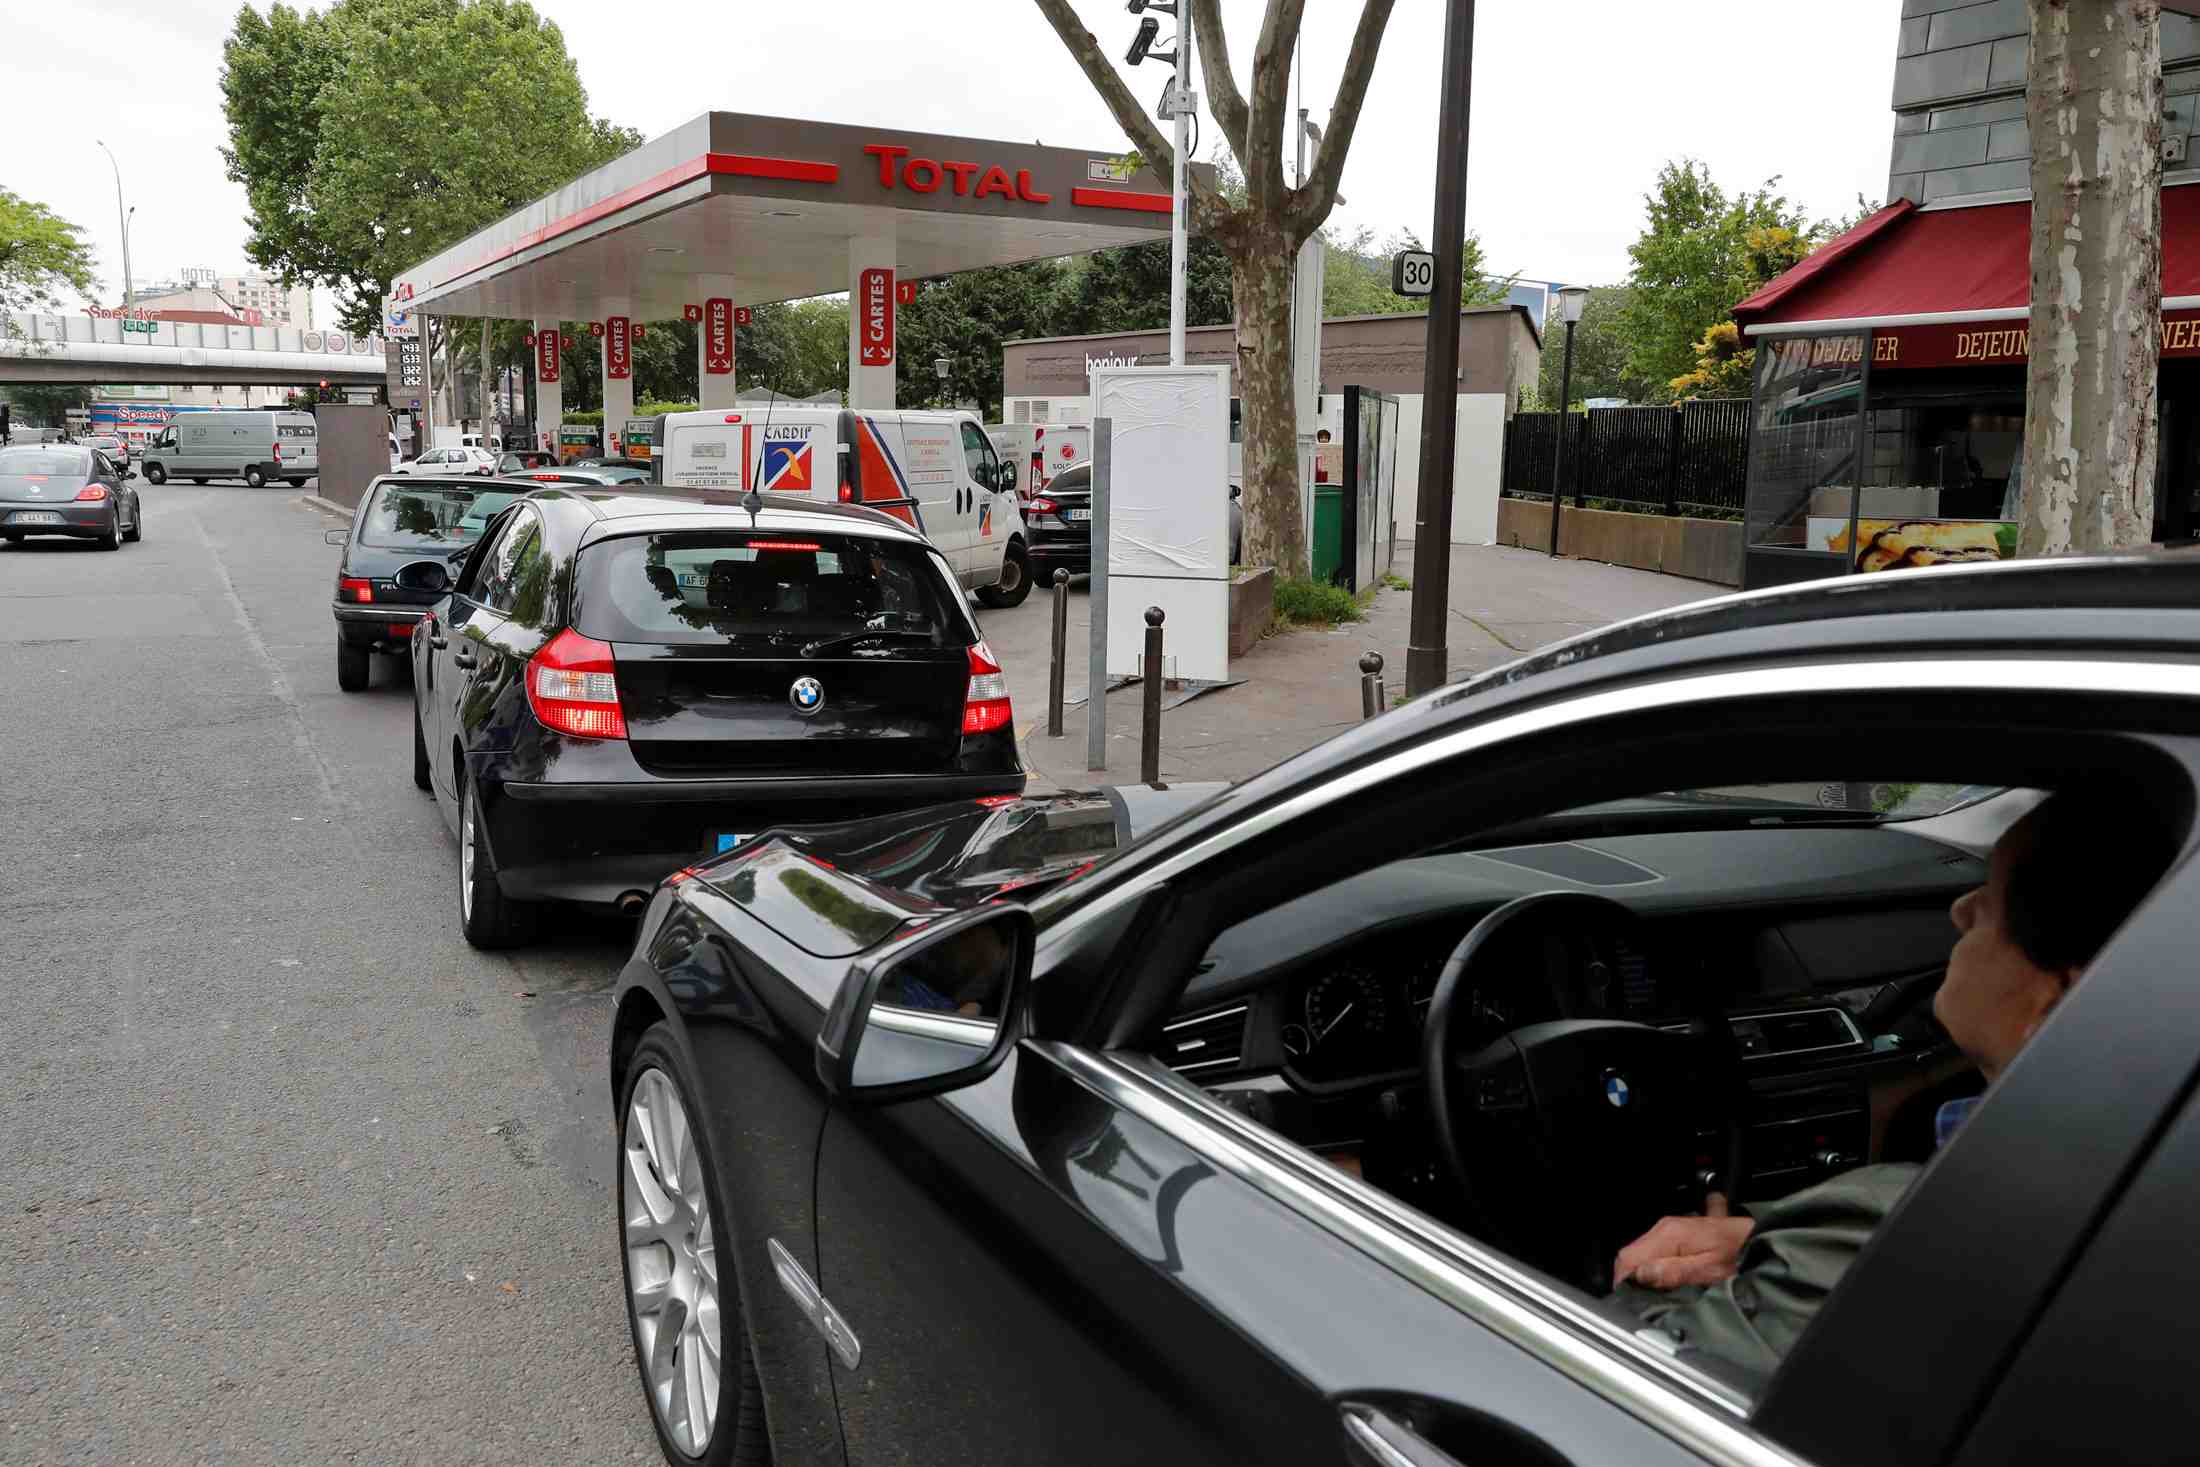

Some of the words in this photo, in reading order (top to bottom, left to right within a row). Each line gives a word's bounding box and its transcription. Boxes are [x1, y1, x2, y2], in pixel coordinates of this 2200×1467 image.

[181, 267, 217, 281] HOTEL
[1406, 261, 1431, 285] 30
[689, 308, 697, 318] 4
[738, 311, 746, 321] 3
[870, 274, 885, 342] CARTES
[592, 324, 600, 334] 6
[614, 320, 624, 364] CARTES
[713, 303, 726, 355] CARTES
[544, 333, 553, 369] CARTES
[1956, 329, 2030, 360] DEJEUN
